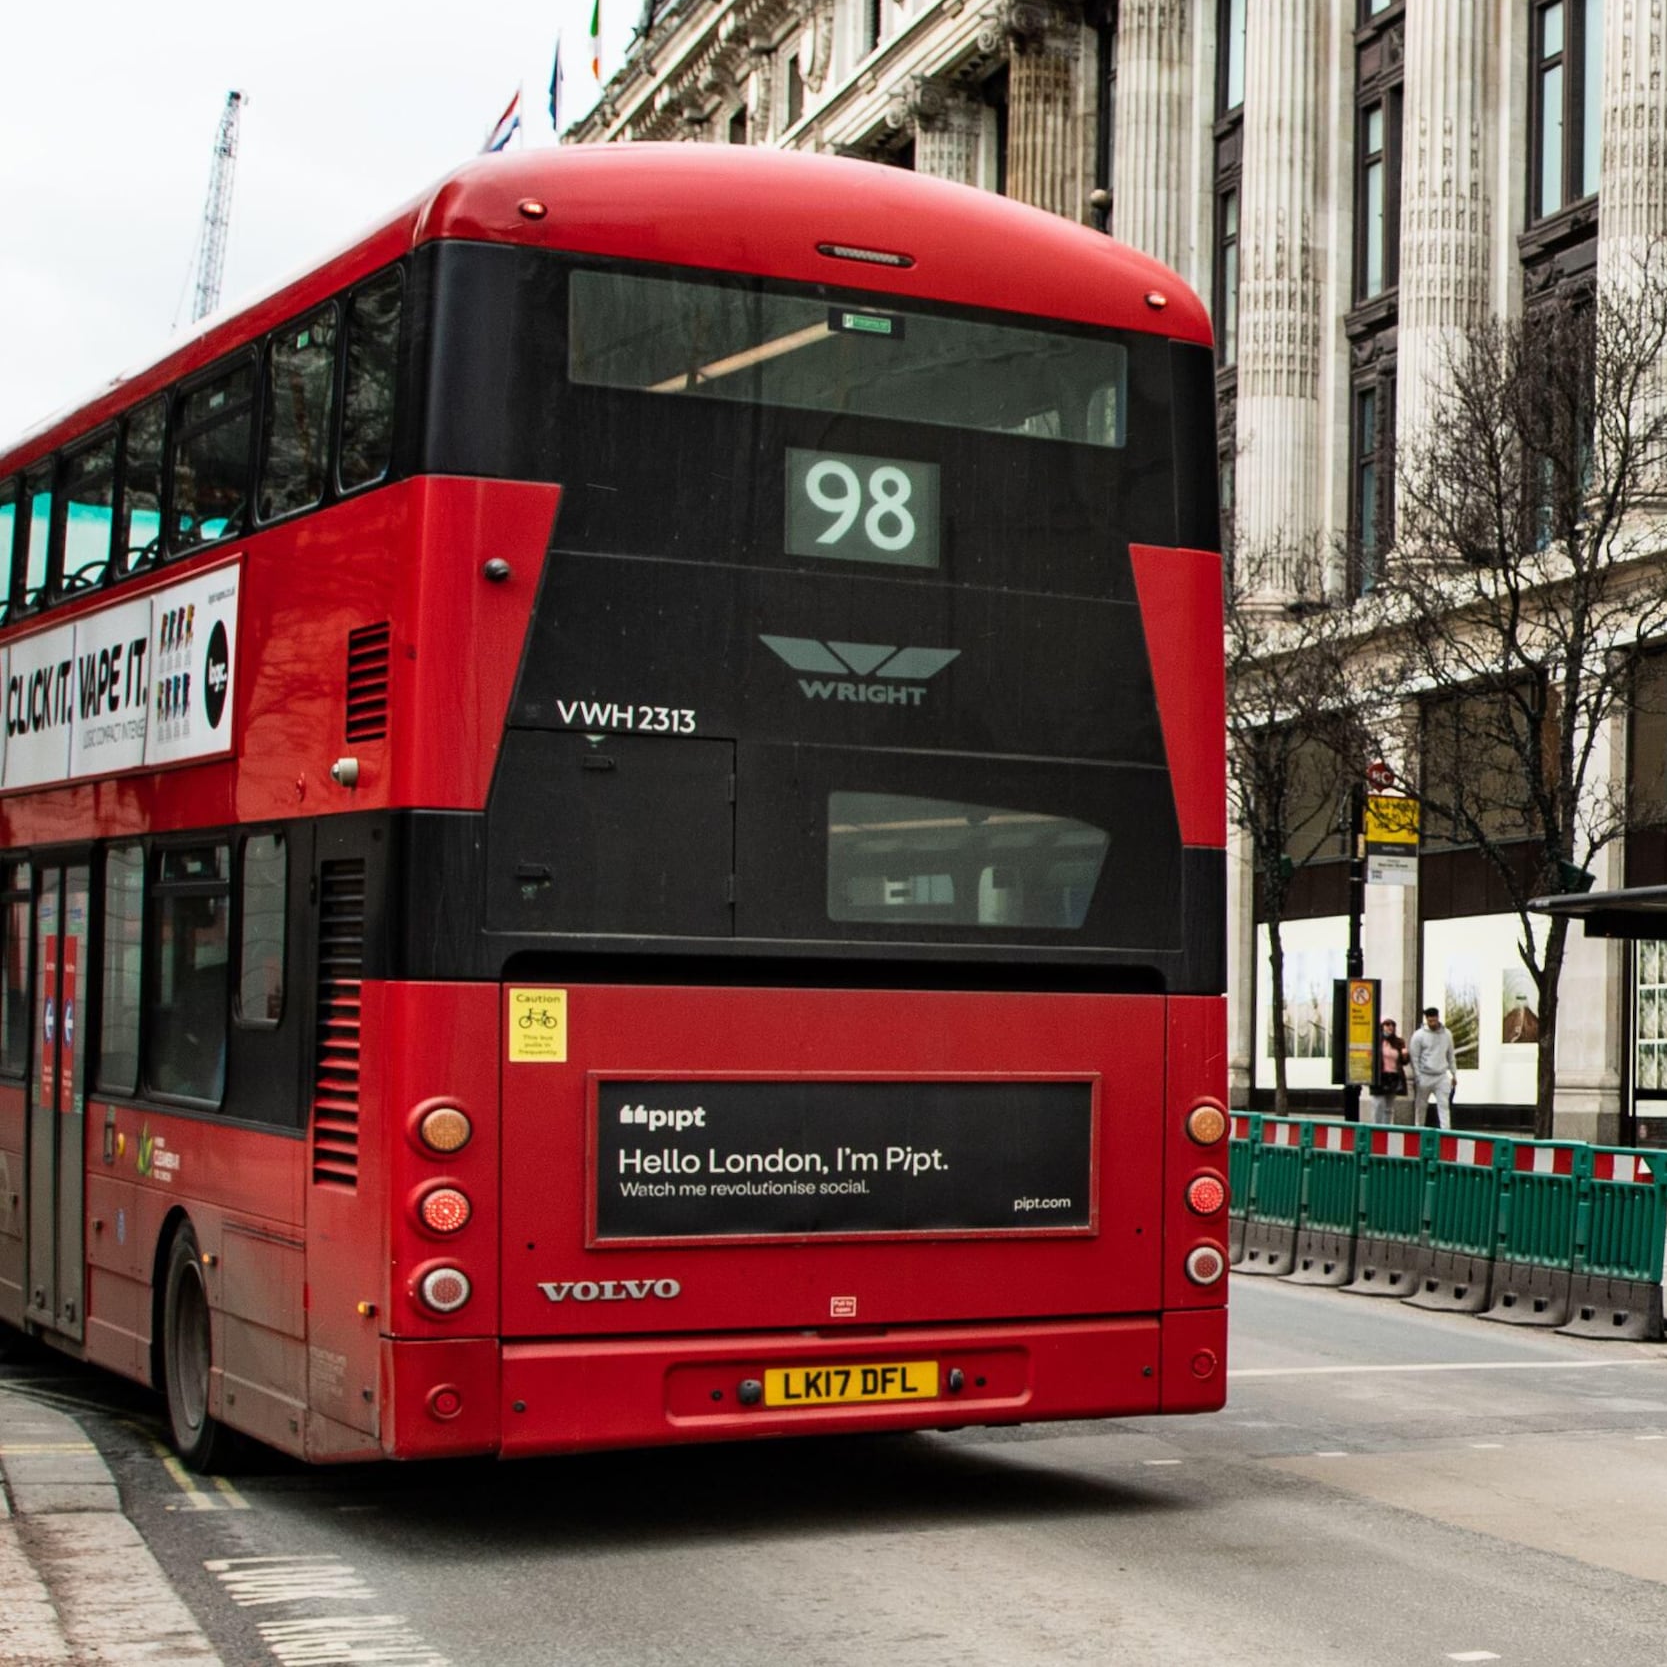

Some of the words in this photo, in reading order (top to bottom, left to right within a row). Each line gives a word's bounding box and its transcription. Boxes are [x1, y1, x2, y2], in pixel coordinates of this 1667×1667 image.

[806, 459, 915, 551] 98
[79, 644, 122, 720] VAPE
[126, 637, 147, 708] IT.
[798, 679, 926, 705] WRIGHT
[516, 994, 561, 1004] Caution
[618, 1148, 701, 1174] Hello
[709, 1148, 829, 1175] London,
[837, 1147, 879, 1173] I'm
[886, 1146, 950, 1176] Pipt.
[620, 1181, 676, 1197] Watch
[679, 1184, 706, 1196] me
[710, 1179, 816, 1195] revolutionise
[819, 1179, 871, 1195] social.
[1013, 1196, 1071, 1212] pipt.com
[538, 1279, 681, 1301] VOLVO
[784, 1369, 851, 1400] LK17
[861, 1367, 918, 1395] DFL
